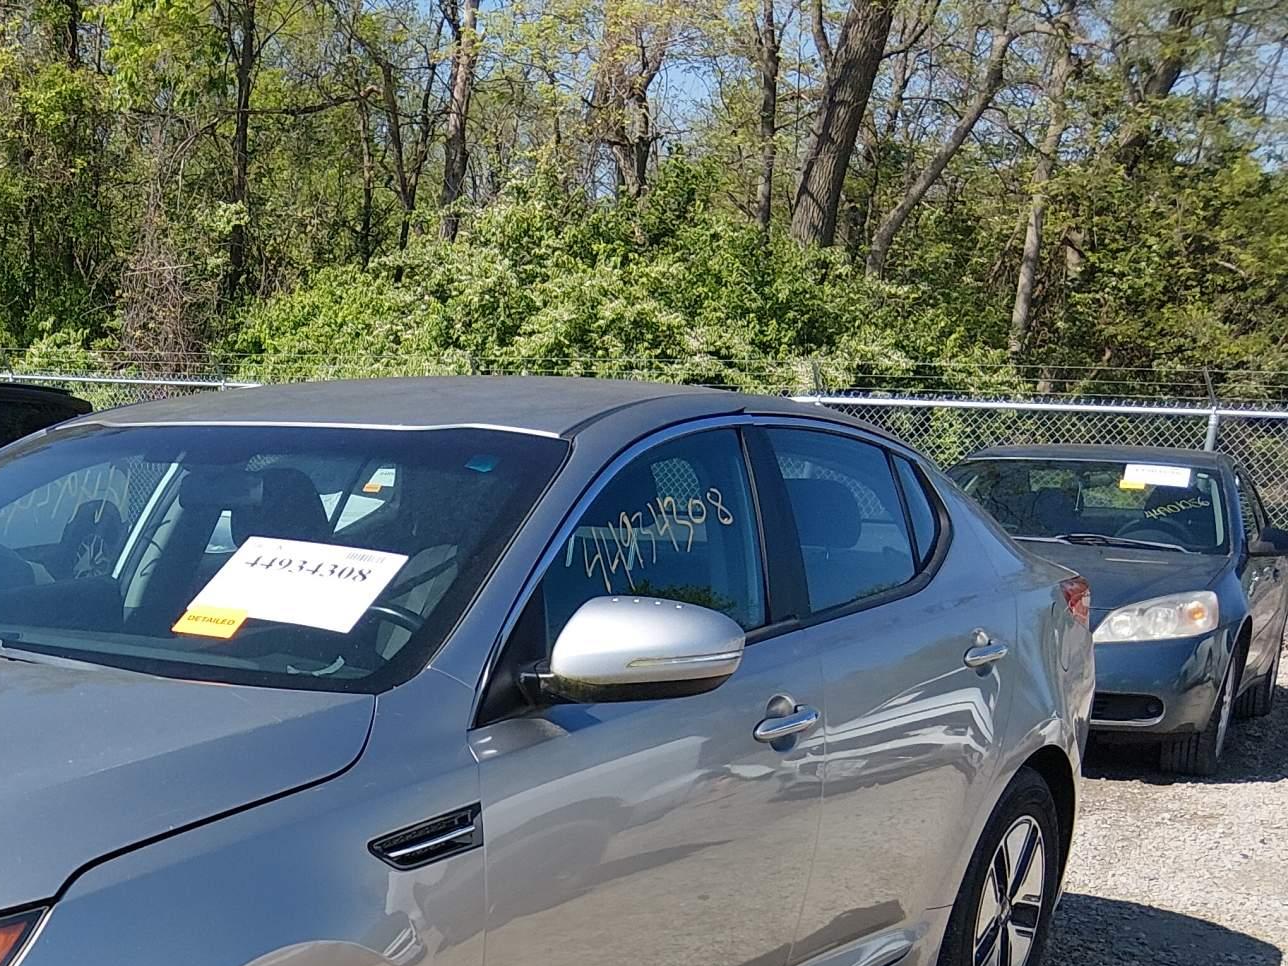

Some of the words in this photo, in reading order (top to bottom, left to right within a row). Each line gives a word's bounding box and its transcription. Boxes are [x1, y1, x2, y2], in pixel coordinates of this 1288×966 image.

[582, 488, 734, 594] 44934308
[245, 555, 372, 582] 44934308
[187, 614, 236, 626] DETAILED
